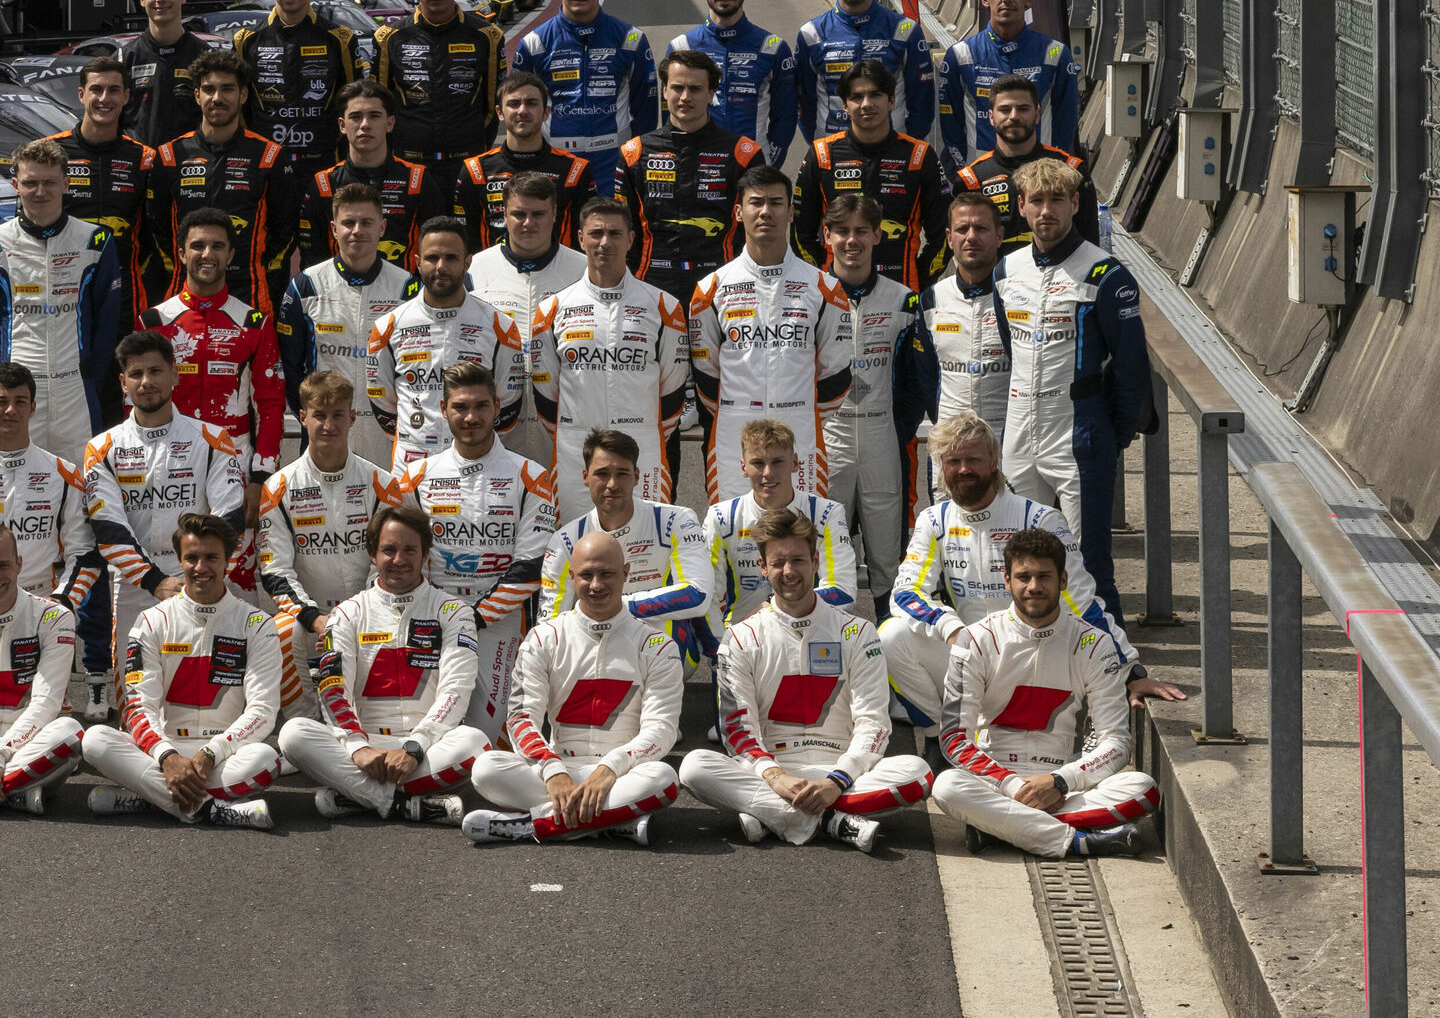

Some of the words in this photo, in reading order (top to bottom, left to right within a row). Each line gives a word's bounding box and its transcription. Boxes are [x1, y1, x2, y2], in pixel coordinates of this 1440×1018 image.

[302, 46, 327, 55] PIRELLI
[449, 44, 474, 52] PIRELLI
[553, 72, 579, 81] PIRELLI
[310, 79, 326, 90] blb
[648, 172, 674, 180] PIRELLI
[94, 231, 106, 246] P1
[1091, 263, 1108, 278] P1
[15, 285, 40, 294] PIRELLI
[408, 282, 419, 297] P1
[722, 282, 756, 293] Tresor
[908, 294, 920, 309] P1
[15, 302, 78, 318] comtoyou
[564, 305, 595, 314] Tresor
[727, 309, 753, 319] PIRELLI
[251, 311, 264, 323] P1
[1007, 311, 1030, 321] PIRELLI
[207, 328, 240, 336] FANATEC
[317, 324, 344, 333] PIRELLI
[400, 326, 431, 335] Tresor
[728, 323, 810, 342] ORANGE1
[936, 324, 961, 333] PIRELLI
[566, 331, 591, 340] PIRELLI
[731, 340, 768, 350] ELECTRIC
[772, 339, 808, 349] MOTORS
[403, 353, 428, 362] PIRELLI
[564, 346, 649, 364] ORANGE1
[568, 363, 607, 372] ELECTRIC
[611, 363, 647, 372] MOTORS
[941, 359, 1011, 377] comtoyou
[115, 446, 144, 456] Tresor
[430, 478, 461, 488] Tresor
[121, 483, 197, 504] ORANGE1
[290, 487, 322, 497] Tresor
[309, 502, 325, 510] Sport
[433, 506, 458, 515] PIRELLI
[296, 517, 324, 526] PIRELLI
[432, 521, 517, 539] ORANGE1
[16, 532, 52, 541] MOTORS
[479, 537, 517, 547] MOTORS
[626, 538, 655, 546] FANATEC
[439, 550, 513, 574] KG32
[943, 559, 968, 570] HYLO
[443, 602, 458, 615] P1
[44, 610, 59, 624] P1
[249, 614, 264, 627] P1
[414, 620, 439, 628] FANATEC
[845, 623, 859, 641] P1
[362, 633, 390, 644] PIRELLI
[649, 636, 665, 649] P1
[1080, 632, 1097, 651] P1
[163, 643, 190, 653] PIRELLI
[492, 640, 508, 672] Sport
[500, 663, 512, 706] customer
[506, 636, 518, 663] racing
[319, 677, 342, 689] PIRELLI
[489, 672, 503, 702] Audi
[793, 740, 801, 748] D.
[802, 739, 842, 751] MARSCHALL
[1085, 757, 1102, 770] Audi
[1100, 746, 1118, 763] Sport
